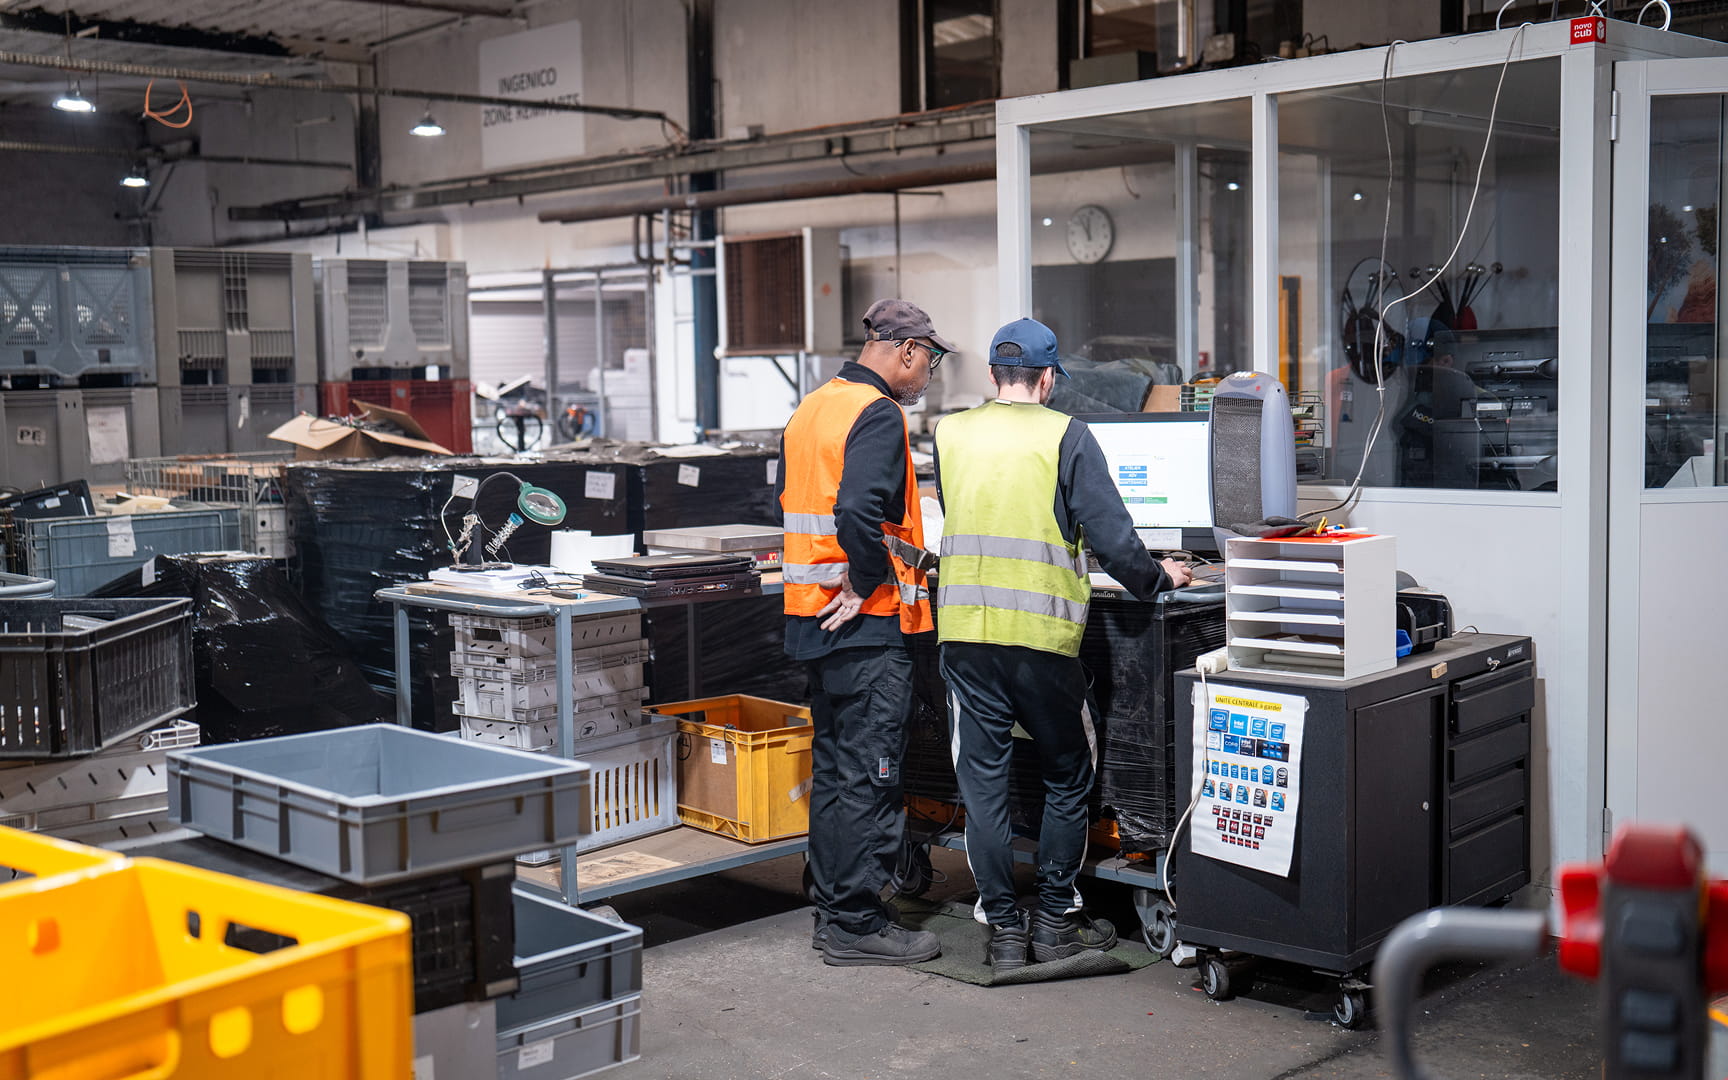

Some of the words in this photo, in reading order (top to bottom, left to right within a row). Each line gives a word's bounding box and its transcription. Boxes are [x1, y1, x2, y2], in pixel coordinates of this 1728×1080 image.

[1574, 29, 1592, 38] cub
[498, 67, 557, 94] INGENICO
[1090, 589, 1116, 598] anutan
[1232, 699, 1258, 708] CENTRALE
